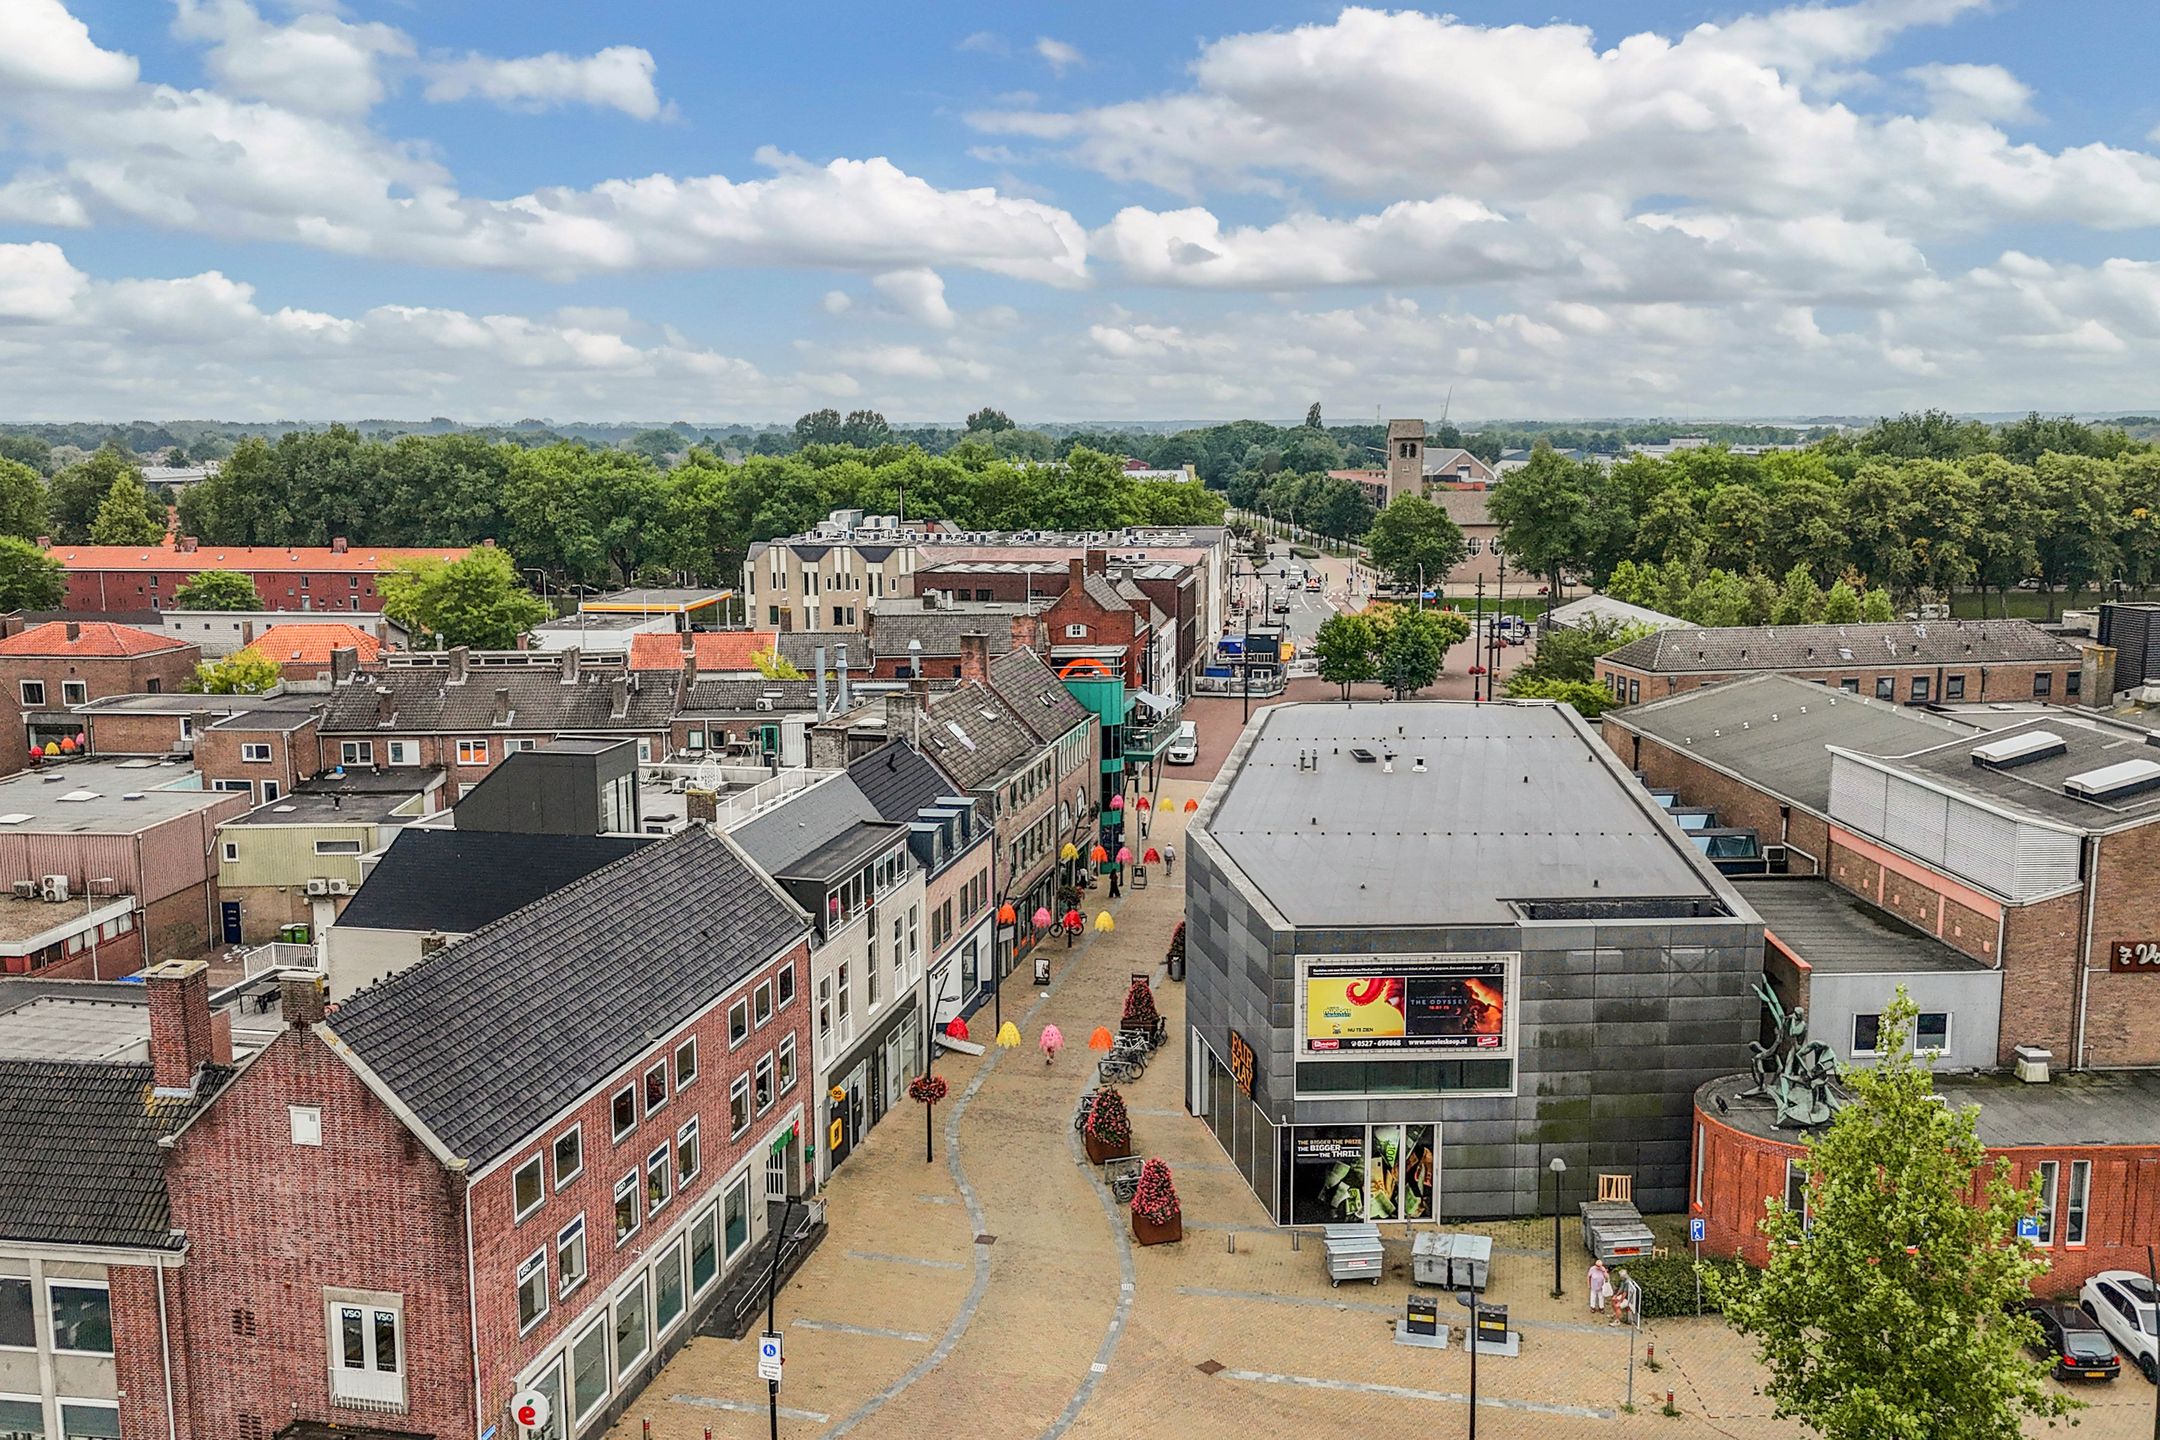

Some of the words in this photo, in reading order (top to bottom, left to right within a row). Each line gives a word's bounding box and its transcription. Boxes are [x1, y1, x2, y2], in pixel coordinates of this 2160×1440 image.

[1408, 1038, 1467, 1046] www.movieskoop.nl
[1231, 1030, 1253, 1073] FAIR
[1231, 1053, 1253, 1092] PLAY
[1693, 1221, 1701, 1232] P
[343, 1309, 361, 1318] VSO
[375, 1312, 393, 1322] VSO
